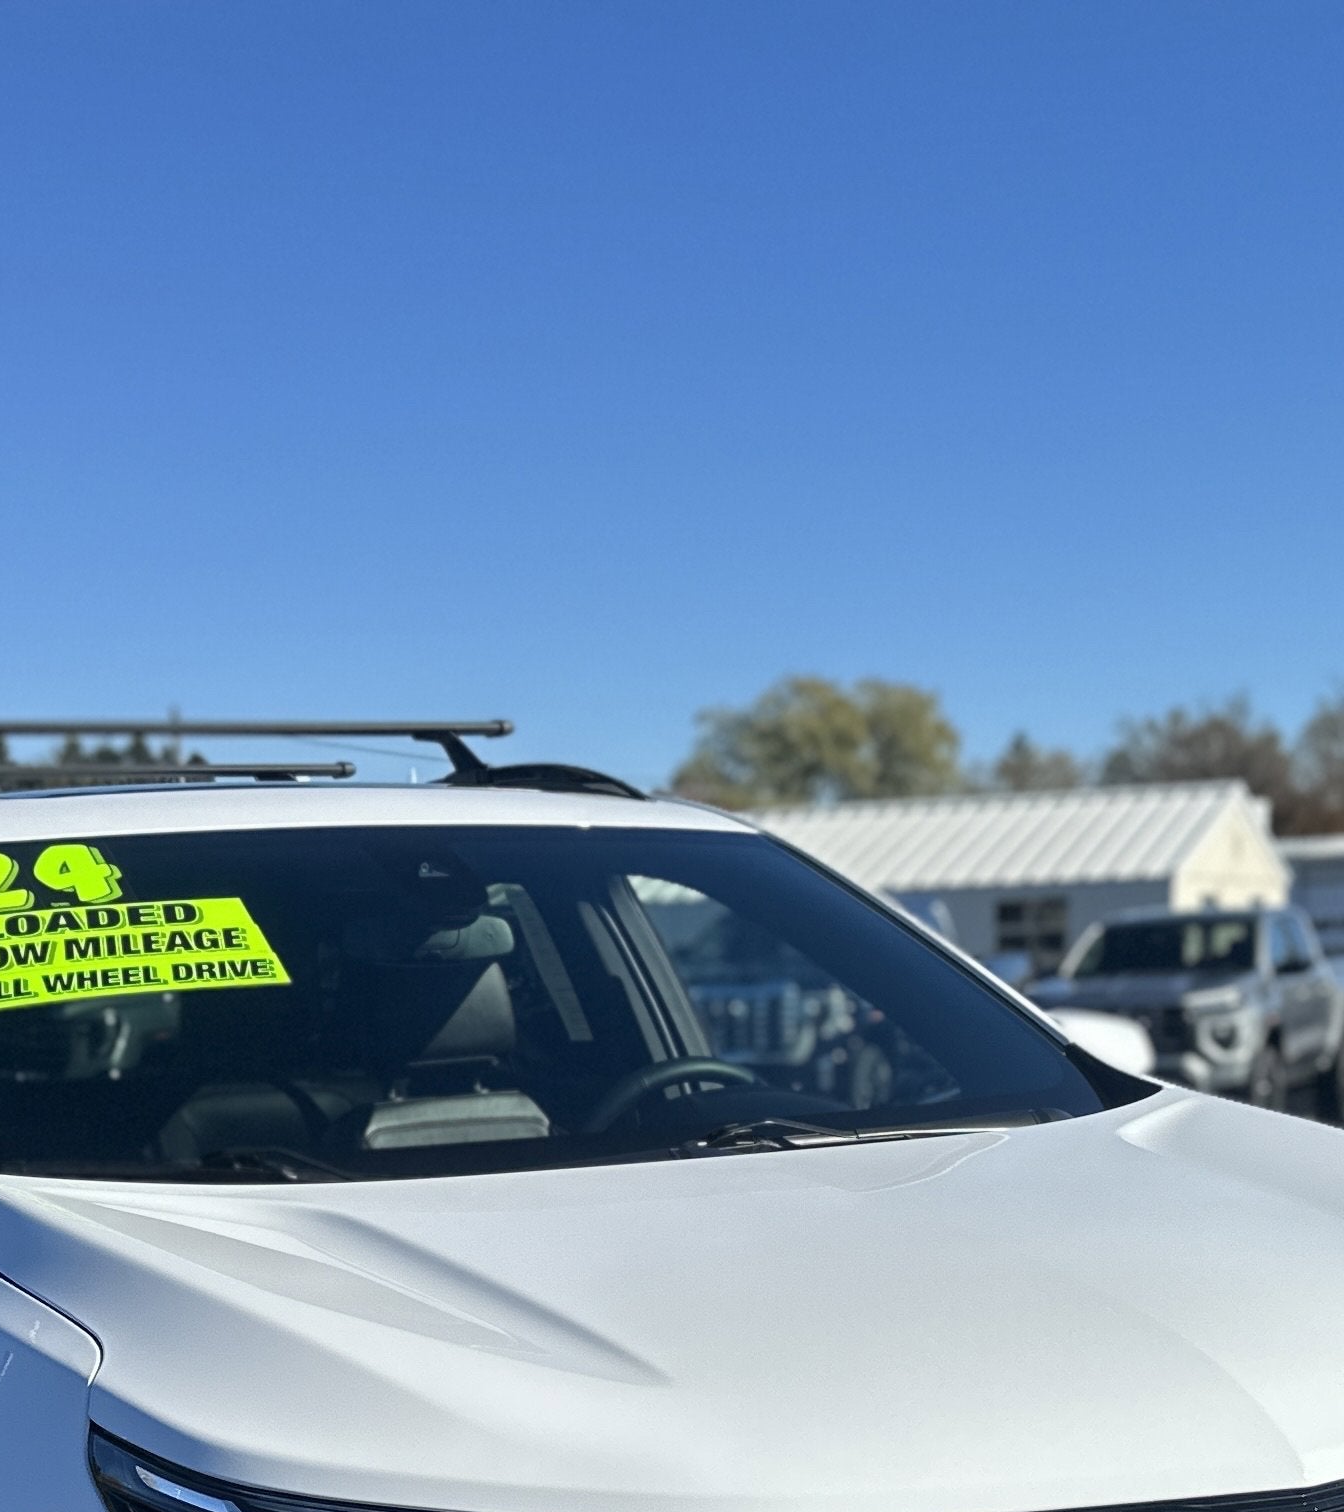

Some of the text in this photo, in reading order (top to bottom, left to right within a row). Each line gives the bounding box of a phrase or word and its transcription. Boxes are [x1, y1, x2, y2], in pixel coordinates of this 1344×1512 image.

[64, 926, 249, 962] MILEAGE
[43, 966, 168, 993] WHEEL
[172, 958, 275, 984] DRIVE
